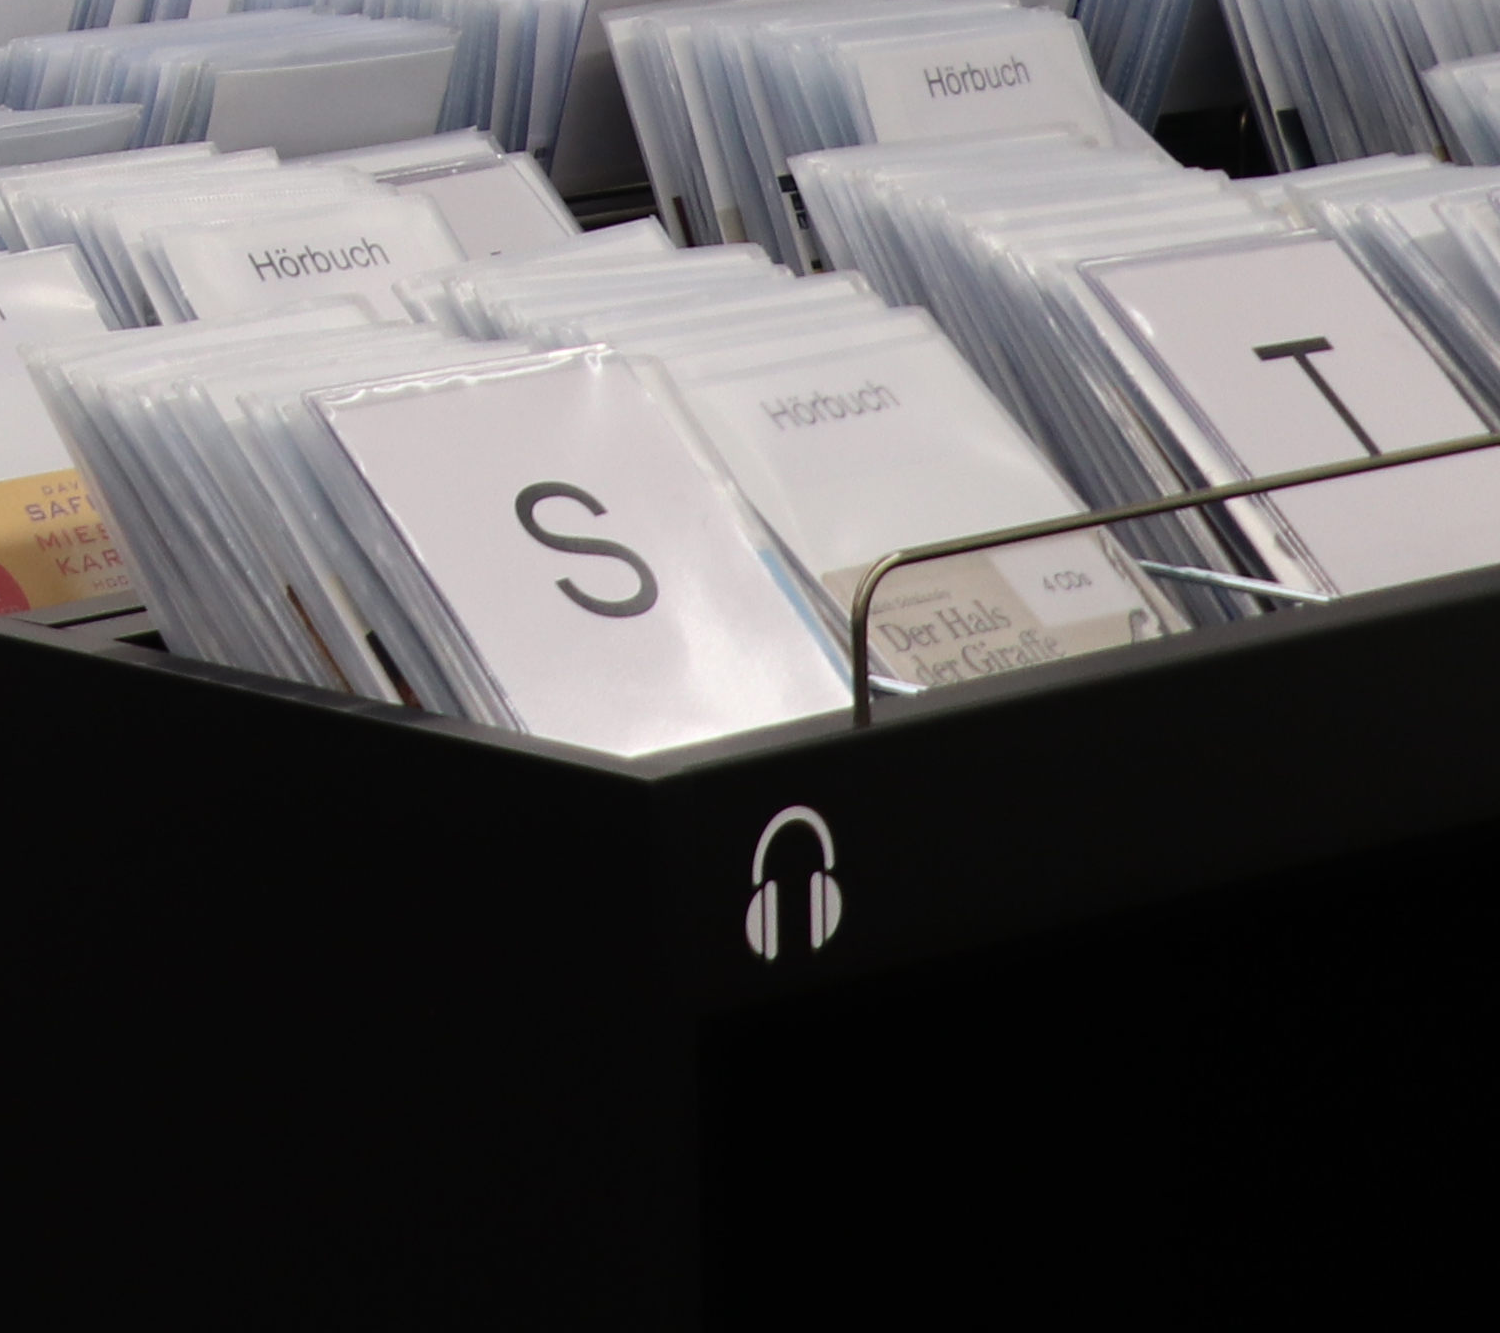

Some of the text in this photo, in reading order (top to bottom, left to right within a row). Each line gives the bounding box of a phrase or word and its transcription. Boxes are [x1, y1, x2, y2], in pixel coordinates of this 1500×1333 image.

[923, 55, 1031, 98] Hörbuch
[247, 236, 391, 282] Hörbuch
[759, 381, 902, 431] Hörbuch
[1252, 336, 1382, 455] T
[513, 480, 659, 619] S
[876, 619, 944, 654] Der
[934, 598, 1013, 642] Hals
[910, 628, 1068, 684] der Giraffe
